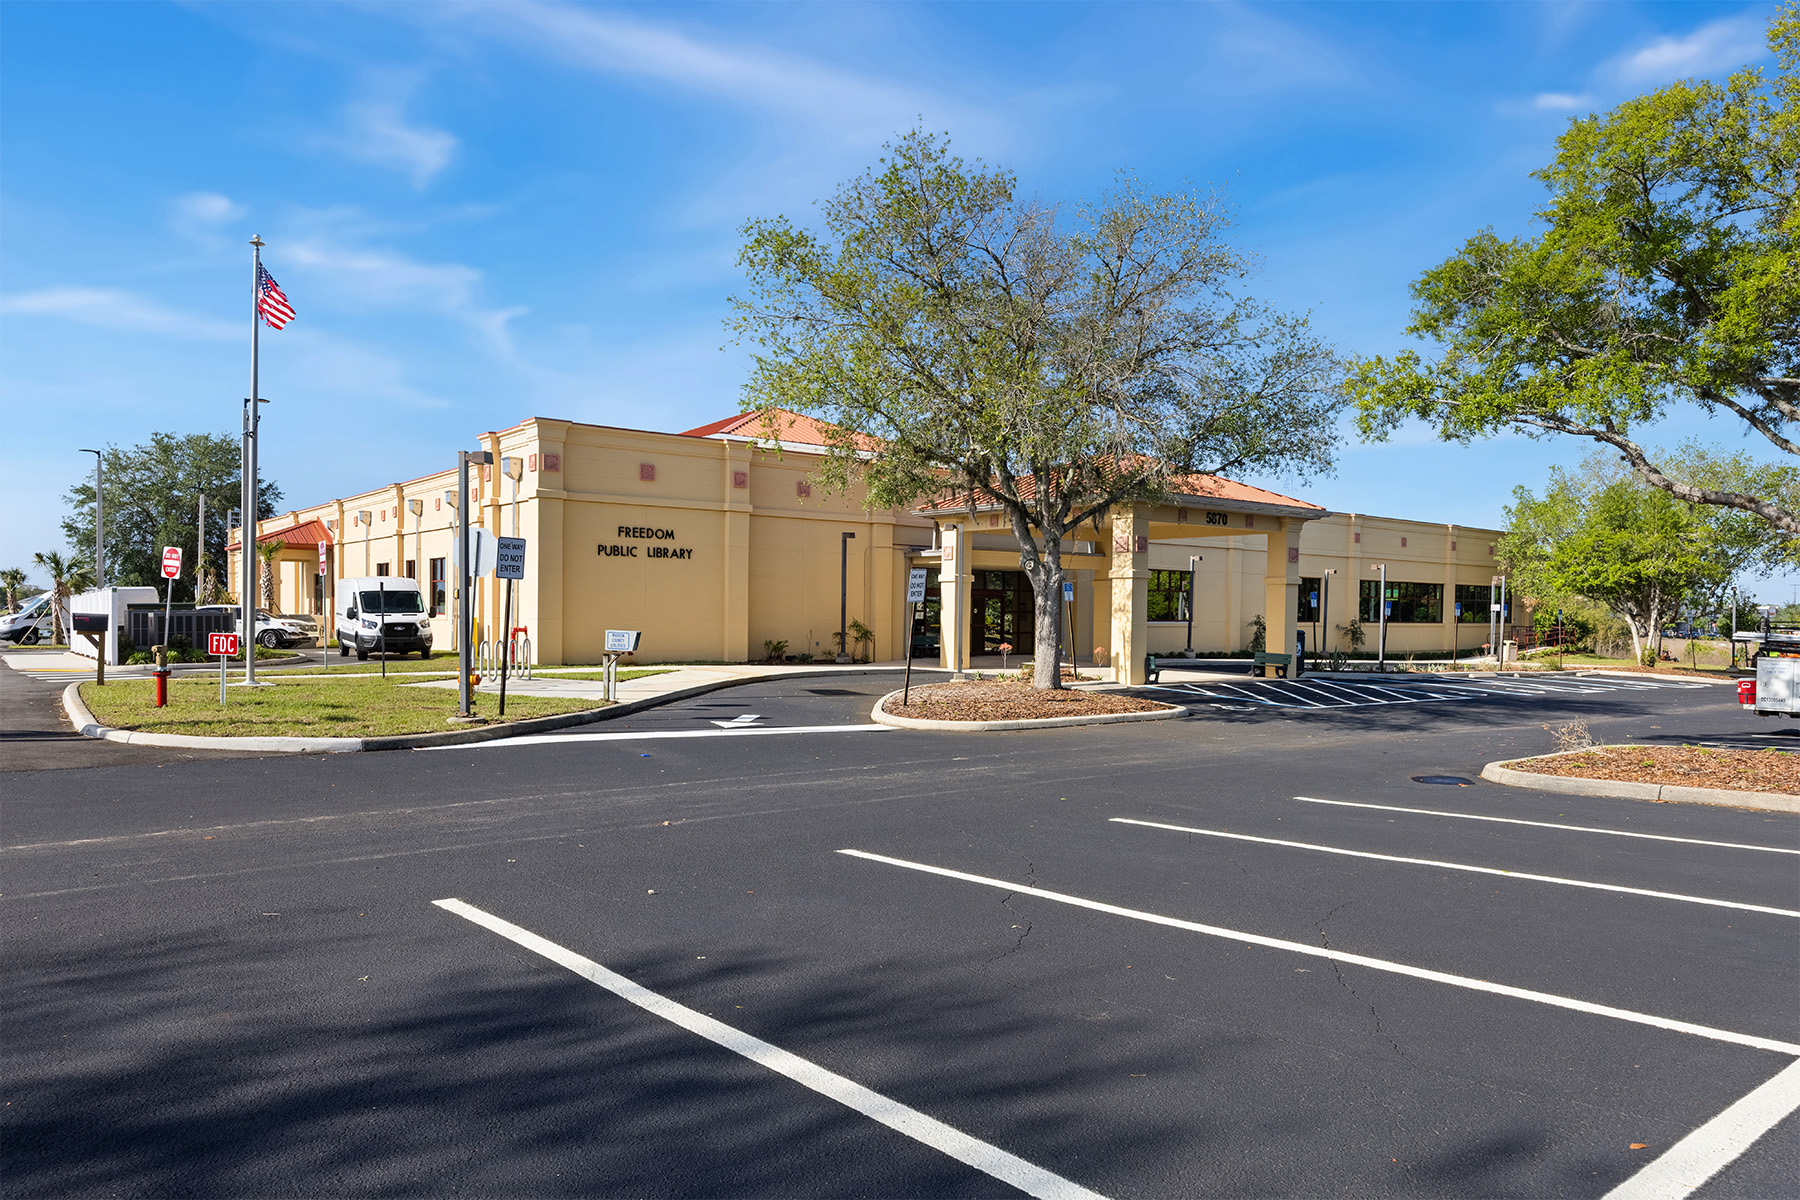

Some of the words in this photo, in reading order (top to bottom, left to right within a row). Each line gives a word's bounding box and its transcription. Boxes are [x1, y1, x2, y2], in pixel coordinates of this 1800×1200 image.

[1206, 511, 1228, 526] 5870
[618, 526, 675, 540] FREEDOM
[500, 542, 511, 550] ONE
[512, 543, 523, 551] WAY
[597, 544, 638, 557] PUBLIC
[647, 546, 693, 560] LIBRARY
[500, 553, 509, 562] DO
[510, 554, 522, 563] NOT
[500, 564, 521, 573] ENTER
[910, 590, 923, 598] ENTER
[212, 636, 235, 653] FDC
